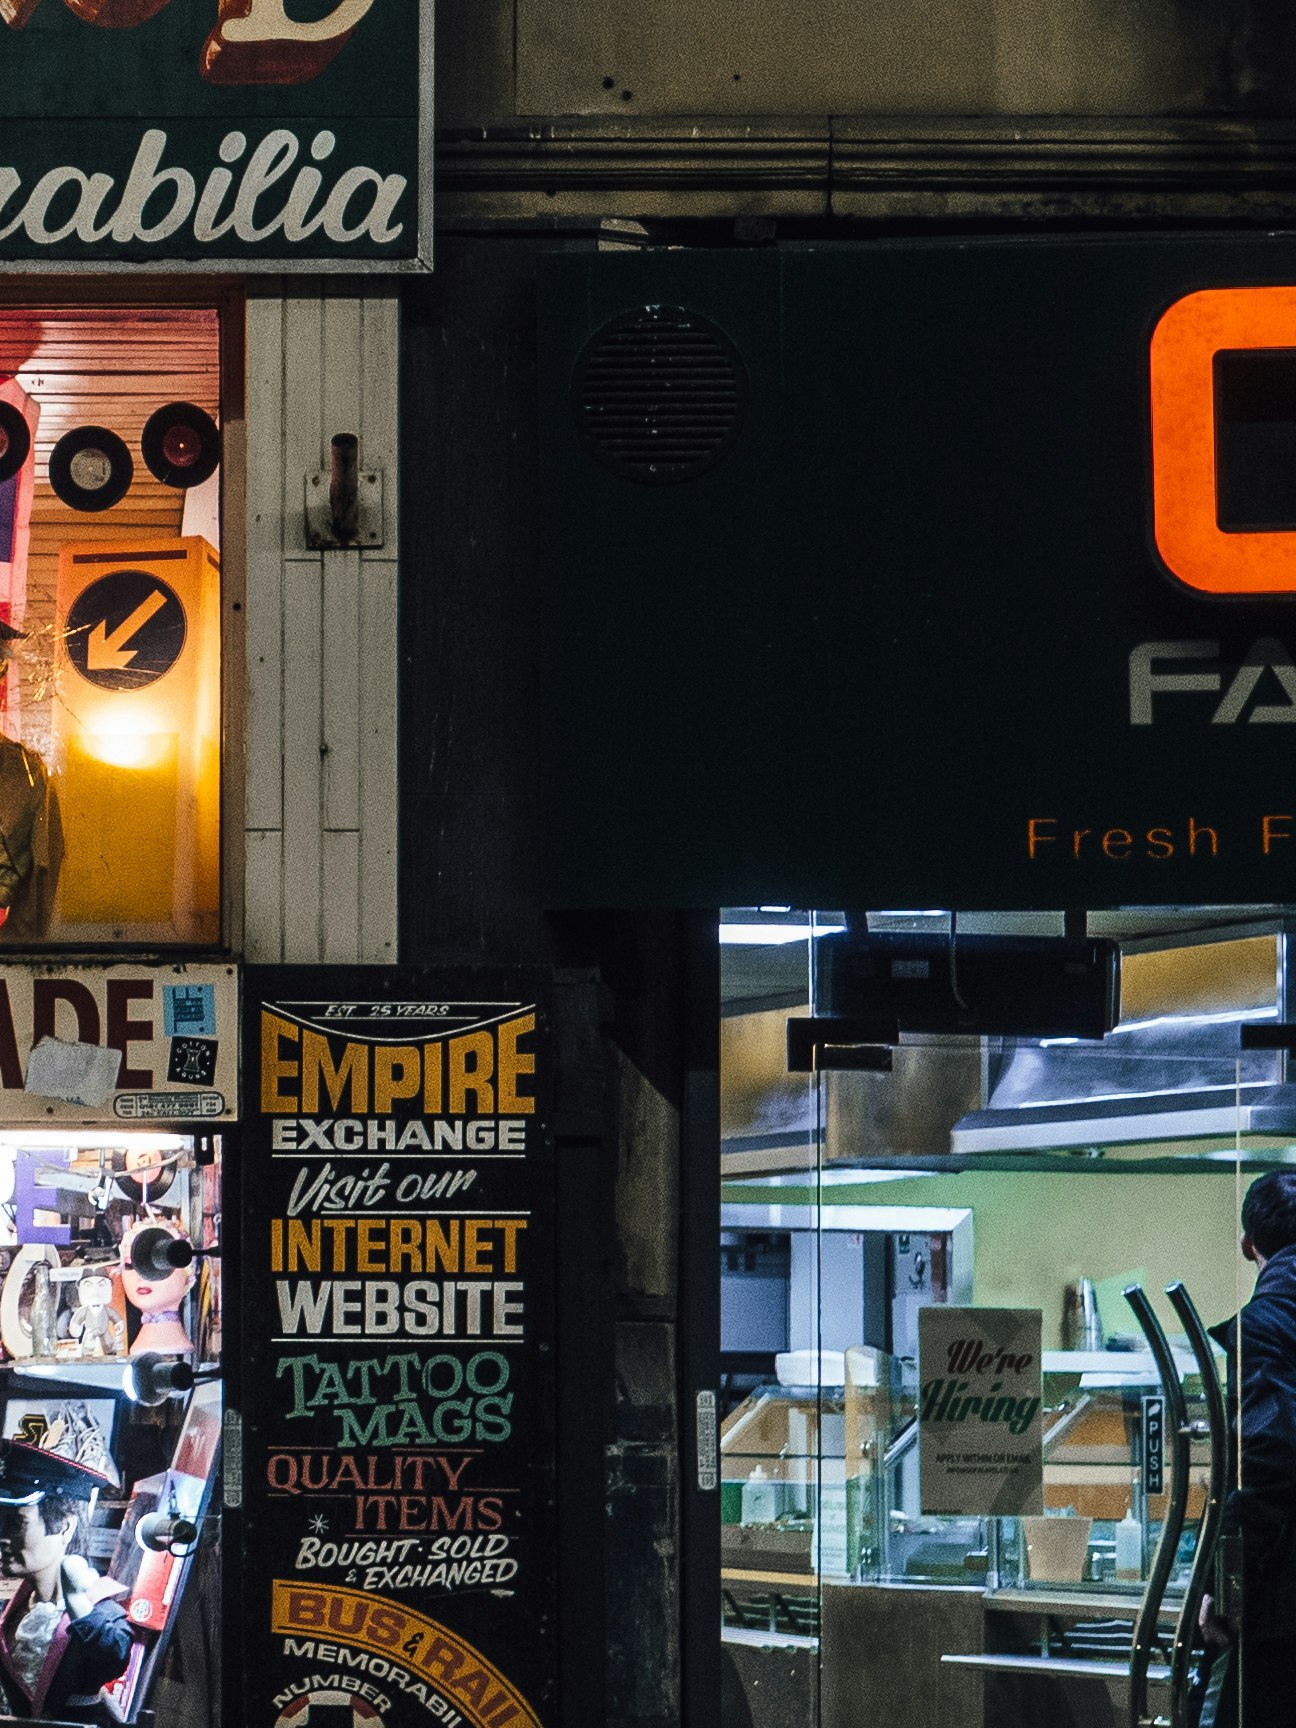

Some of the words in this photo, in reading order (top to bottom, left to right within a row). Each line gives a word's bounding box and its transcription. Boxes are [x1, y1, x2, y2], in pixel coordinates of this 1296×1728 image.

[1027, 818, 1220, 860] Fresh
[370, 1004, 393, 1018] 25
[395, 1003, 450, 1018] YEARS
[260, 1010, 536, 1114] EMPIRE
[272, 1119, 526, 1151] EXCHANGE
[288, 1161, 391, 1217] Visit
[396, 1165, 477, 1203] our
[271, 1219, 528, 1273] INTERNET
[275, 1280, 525, 1335] WEBSITE
[947, 1338, 1033, 1374] We're
[275, 1351, 510, 1419] TATTOO
[920, 1378, 1041, 1435] Hiring
[337, 1392, 514, 1448] MAGS
[266, 1454, 473, 1494] QUALITY
[1147, 1422, 1161, 1487] PUSH
[354, 1495, 503, 1531] ITEMS
[295, 1536, 413, 1571] BOUGHT
[429, 1534, 509, 1560] SOLD
[363, 1558, 518, 1590] EXCHANGED
[288, 1591, 406, 1647] BUS
[272, 1674, 393, 1714] NUMBER
